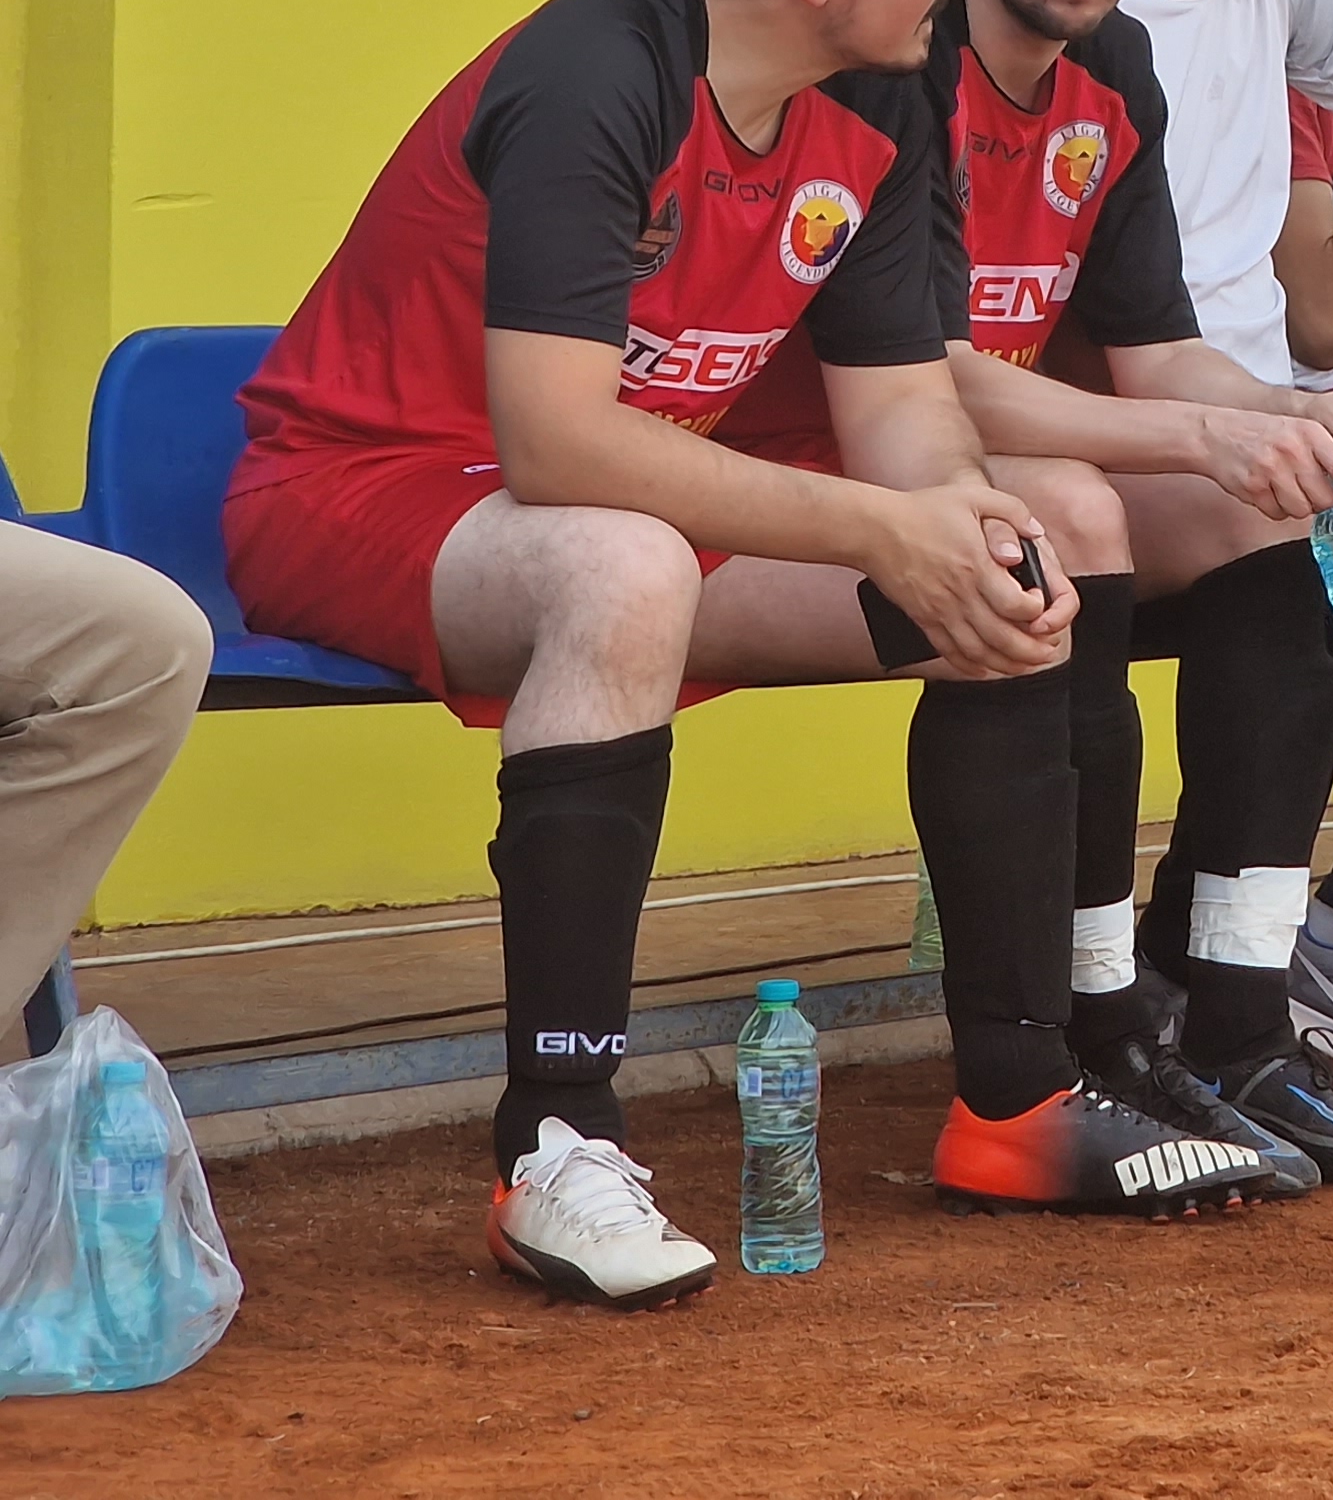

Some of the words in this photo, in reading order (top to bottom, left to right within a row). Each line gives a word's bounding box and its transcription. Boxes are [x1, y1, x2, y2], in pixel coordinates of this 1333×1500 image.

[1061, 125, 1101, 141] LIGA
[803, 184, 842, 203] LIGA
[1114, 1140, 1260, 1197] PUMA
